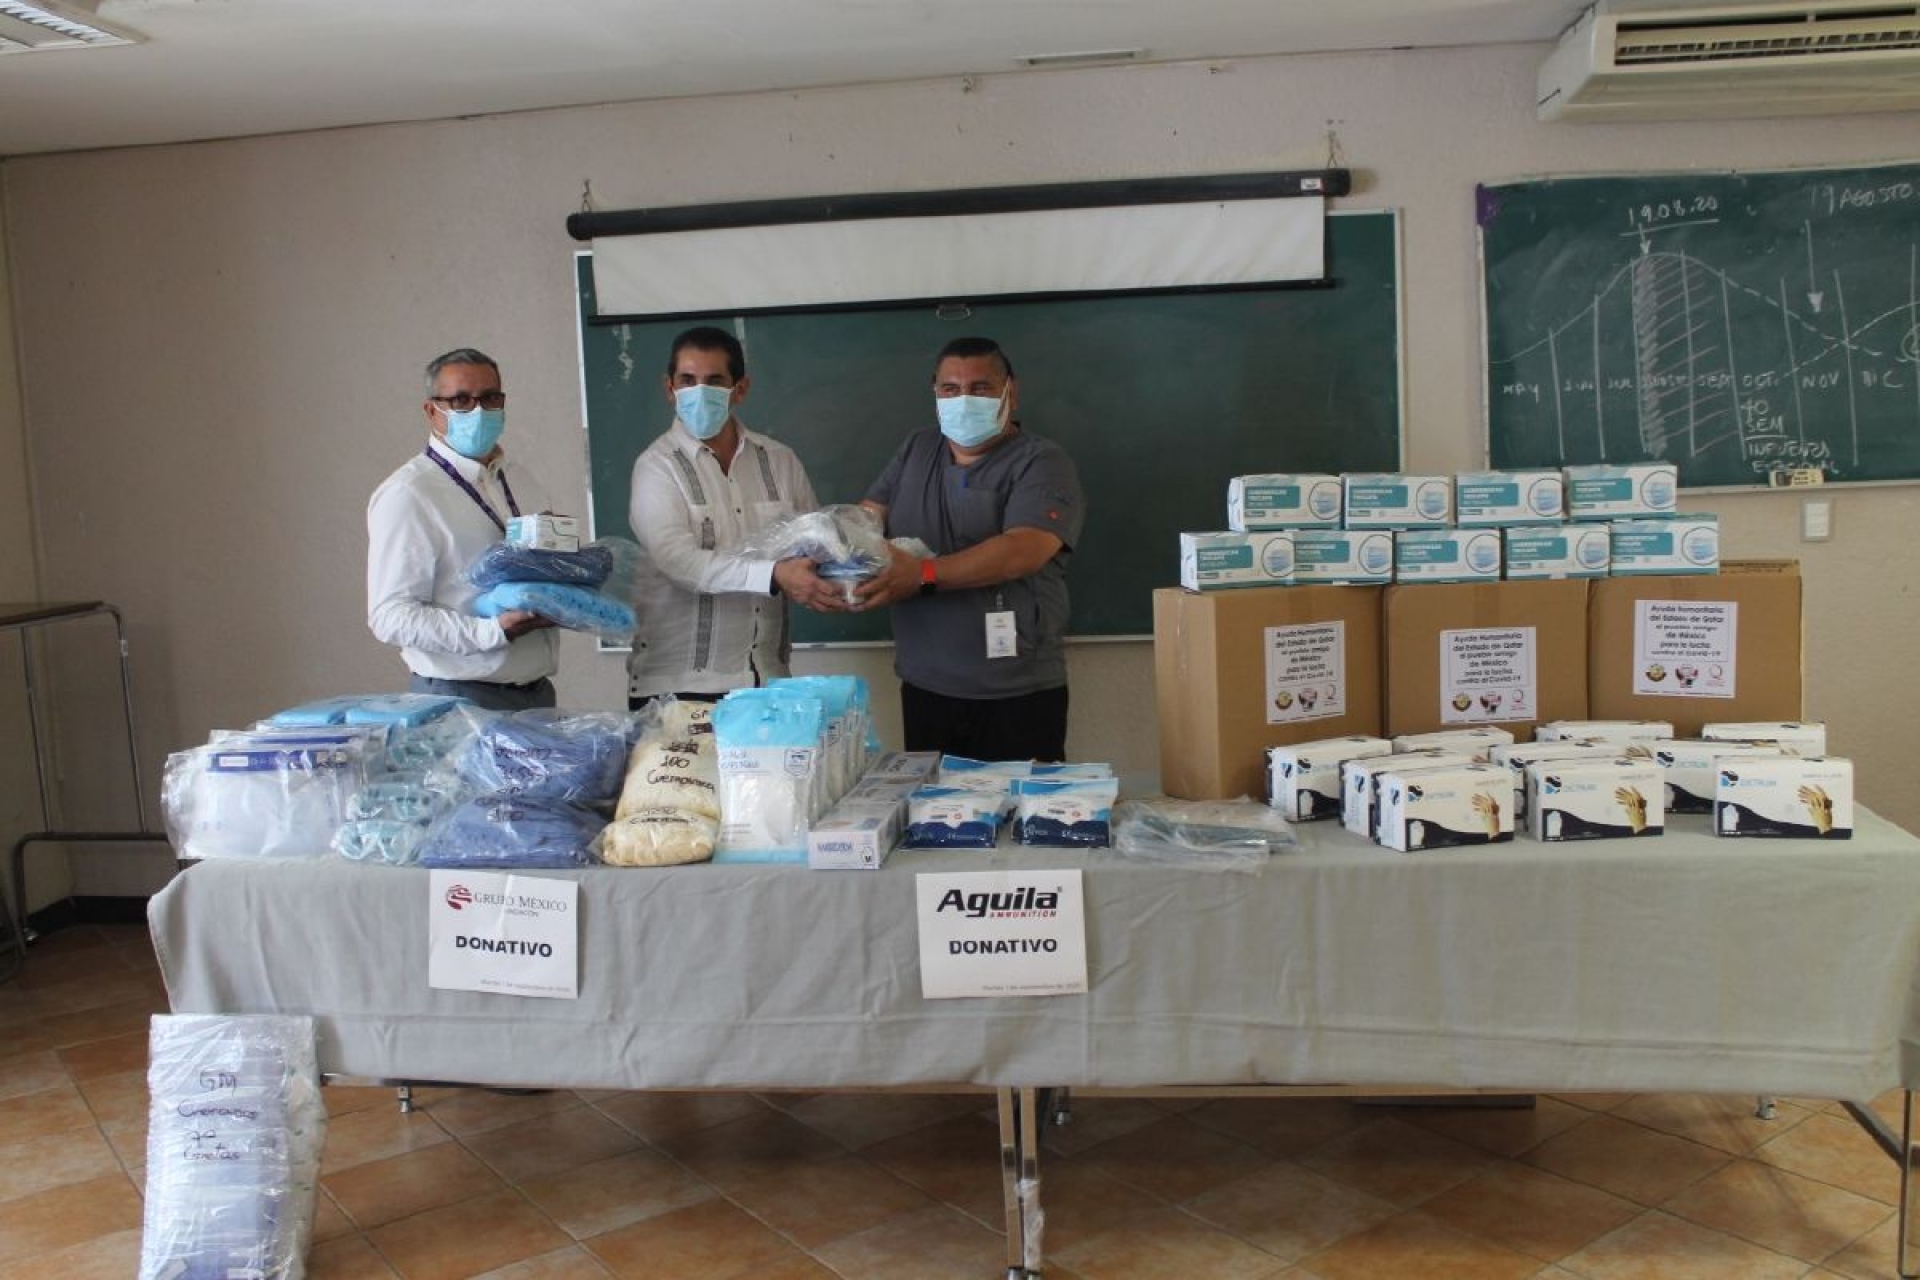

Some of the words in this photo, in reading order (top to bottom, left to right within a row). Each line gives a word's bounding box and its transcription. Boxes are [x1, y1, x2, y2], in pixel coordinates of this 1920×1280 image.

[1802, 371, 1840, 388] NOV
[1747, 414, 1785, 434] SEM
[936, 886, 1059, 918] Aguila
[989, 910, 1057, 919] AMMUNITION
[455, 935, 553, 958] DONATIVO
[949, 938, 1058, 955] DONATIVO
